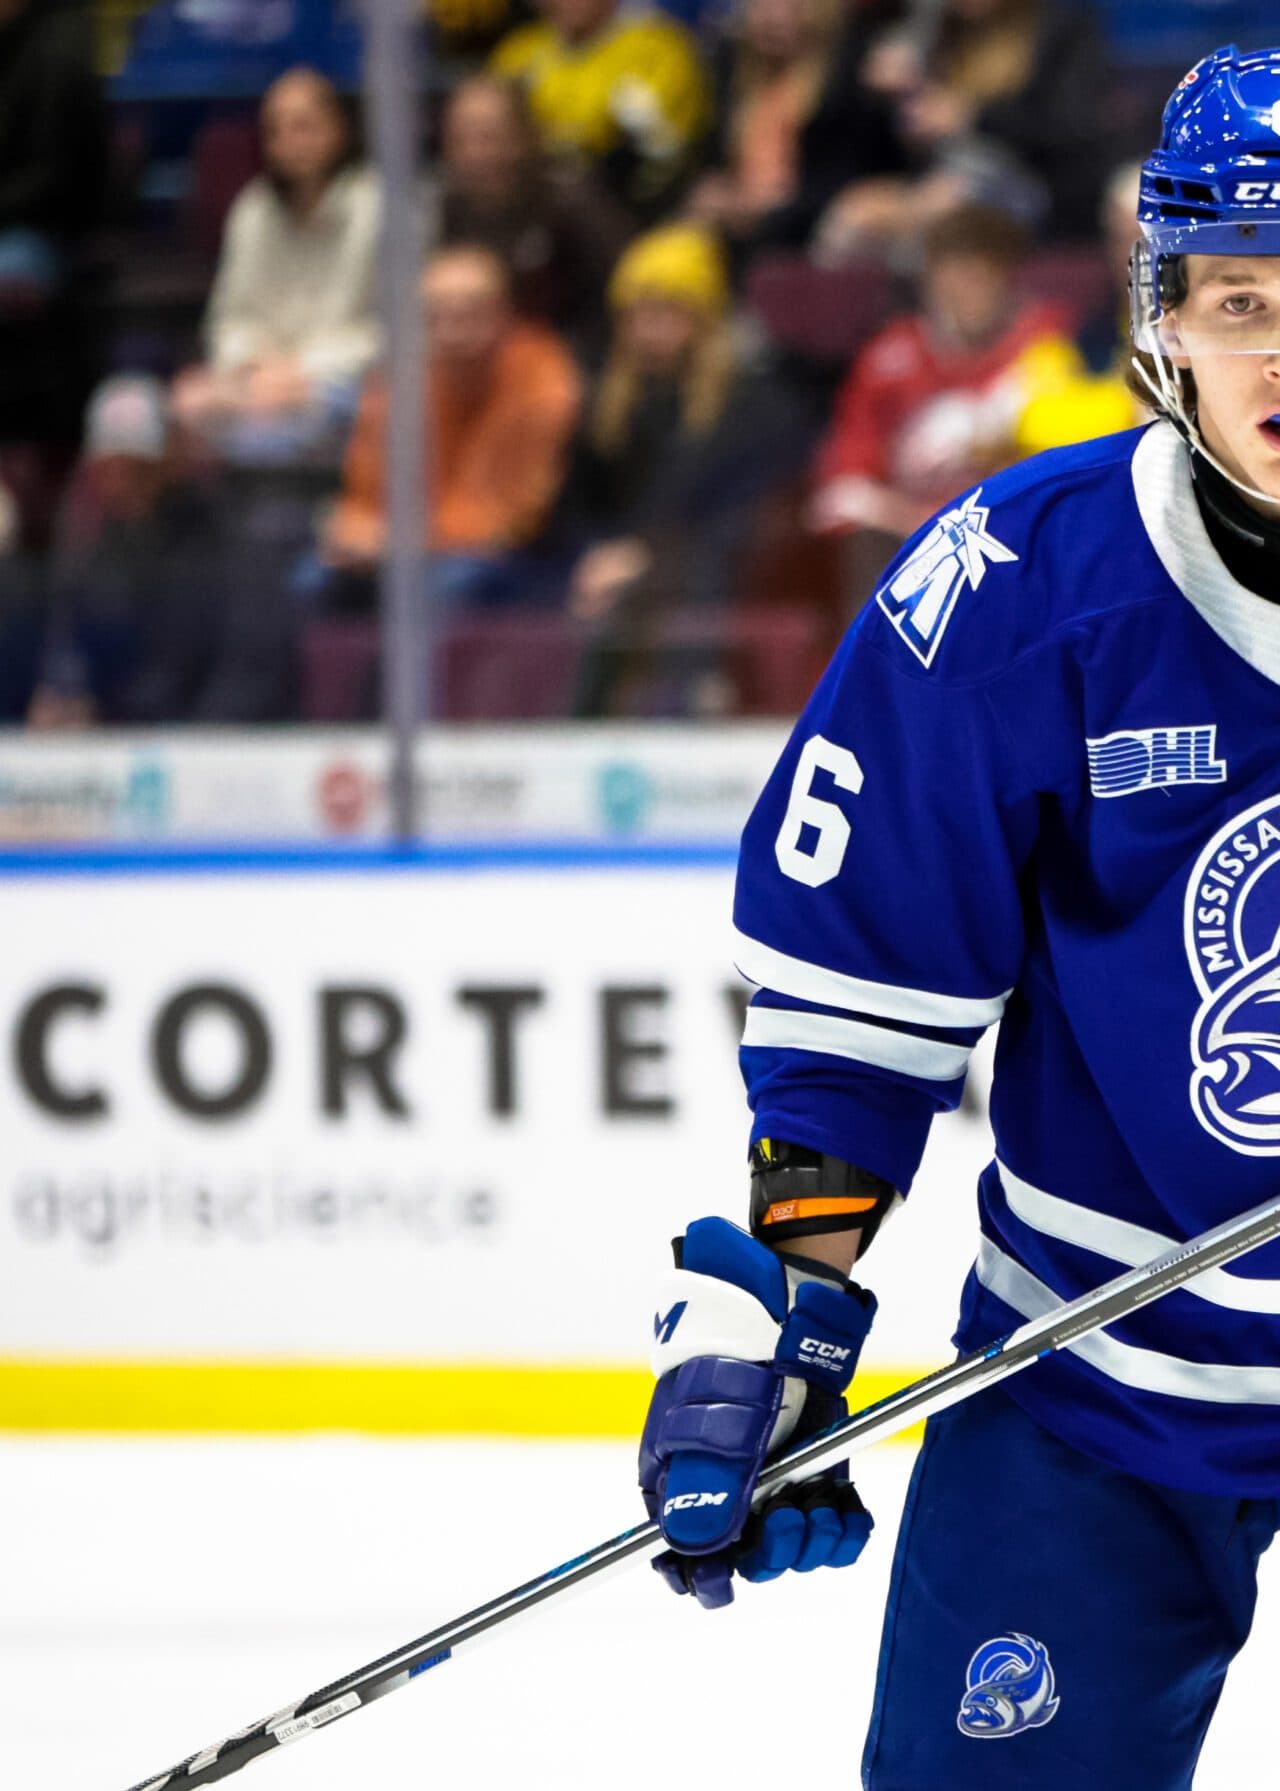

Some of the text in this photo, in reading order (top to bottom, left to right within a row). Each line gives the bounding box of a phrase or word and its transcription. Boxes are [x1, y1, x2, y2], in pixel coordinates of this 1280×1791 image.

[1085, 724, 1227, 798] OHL
[775, 734, 865, 888] 6
[14, 983, 986, 1122] CORTE
[800, 1337, 851, 1361] CCM
[663, 1492, 728, 1516] CCM
